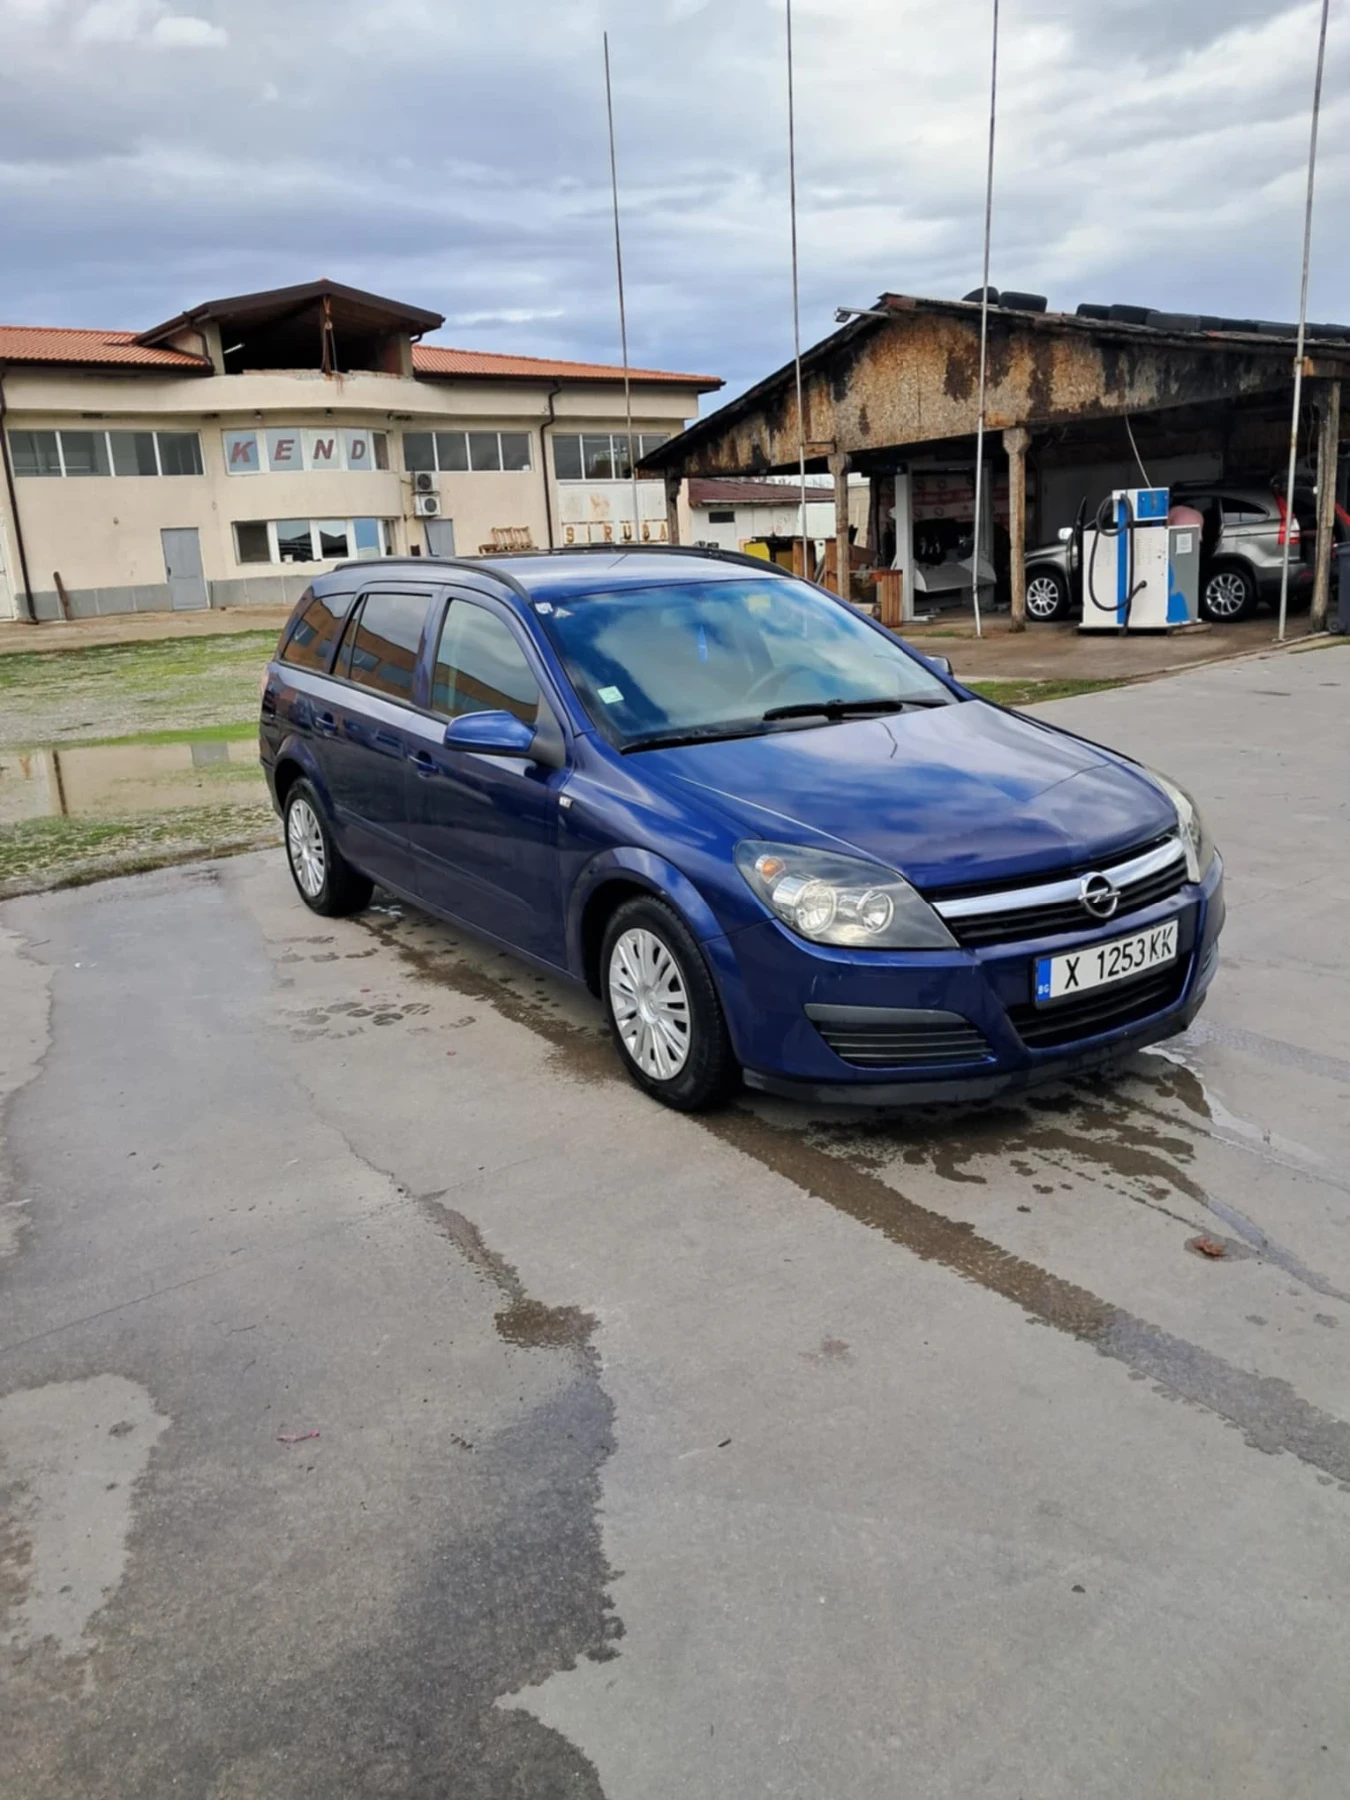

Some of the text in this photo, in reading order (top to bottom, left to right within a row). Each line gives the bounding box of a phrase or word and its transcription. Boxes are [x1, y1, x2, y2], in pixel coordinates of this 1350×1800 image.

[231, 439, 366, 464] KEND
[1064, 956, 1080, 990] X
[1038, 984, 1050, 995] BG
